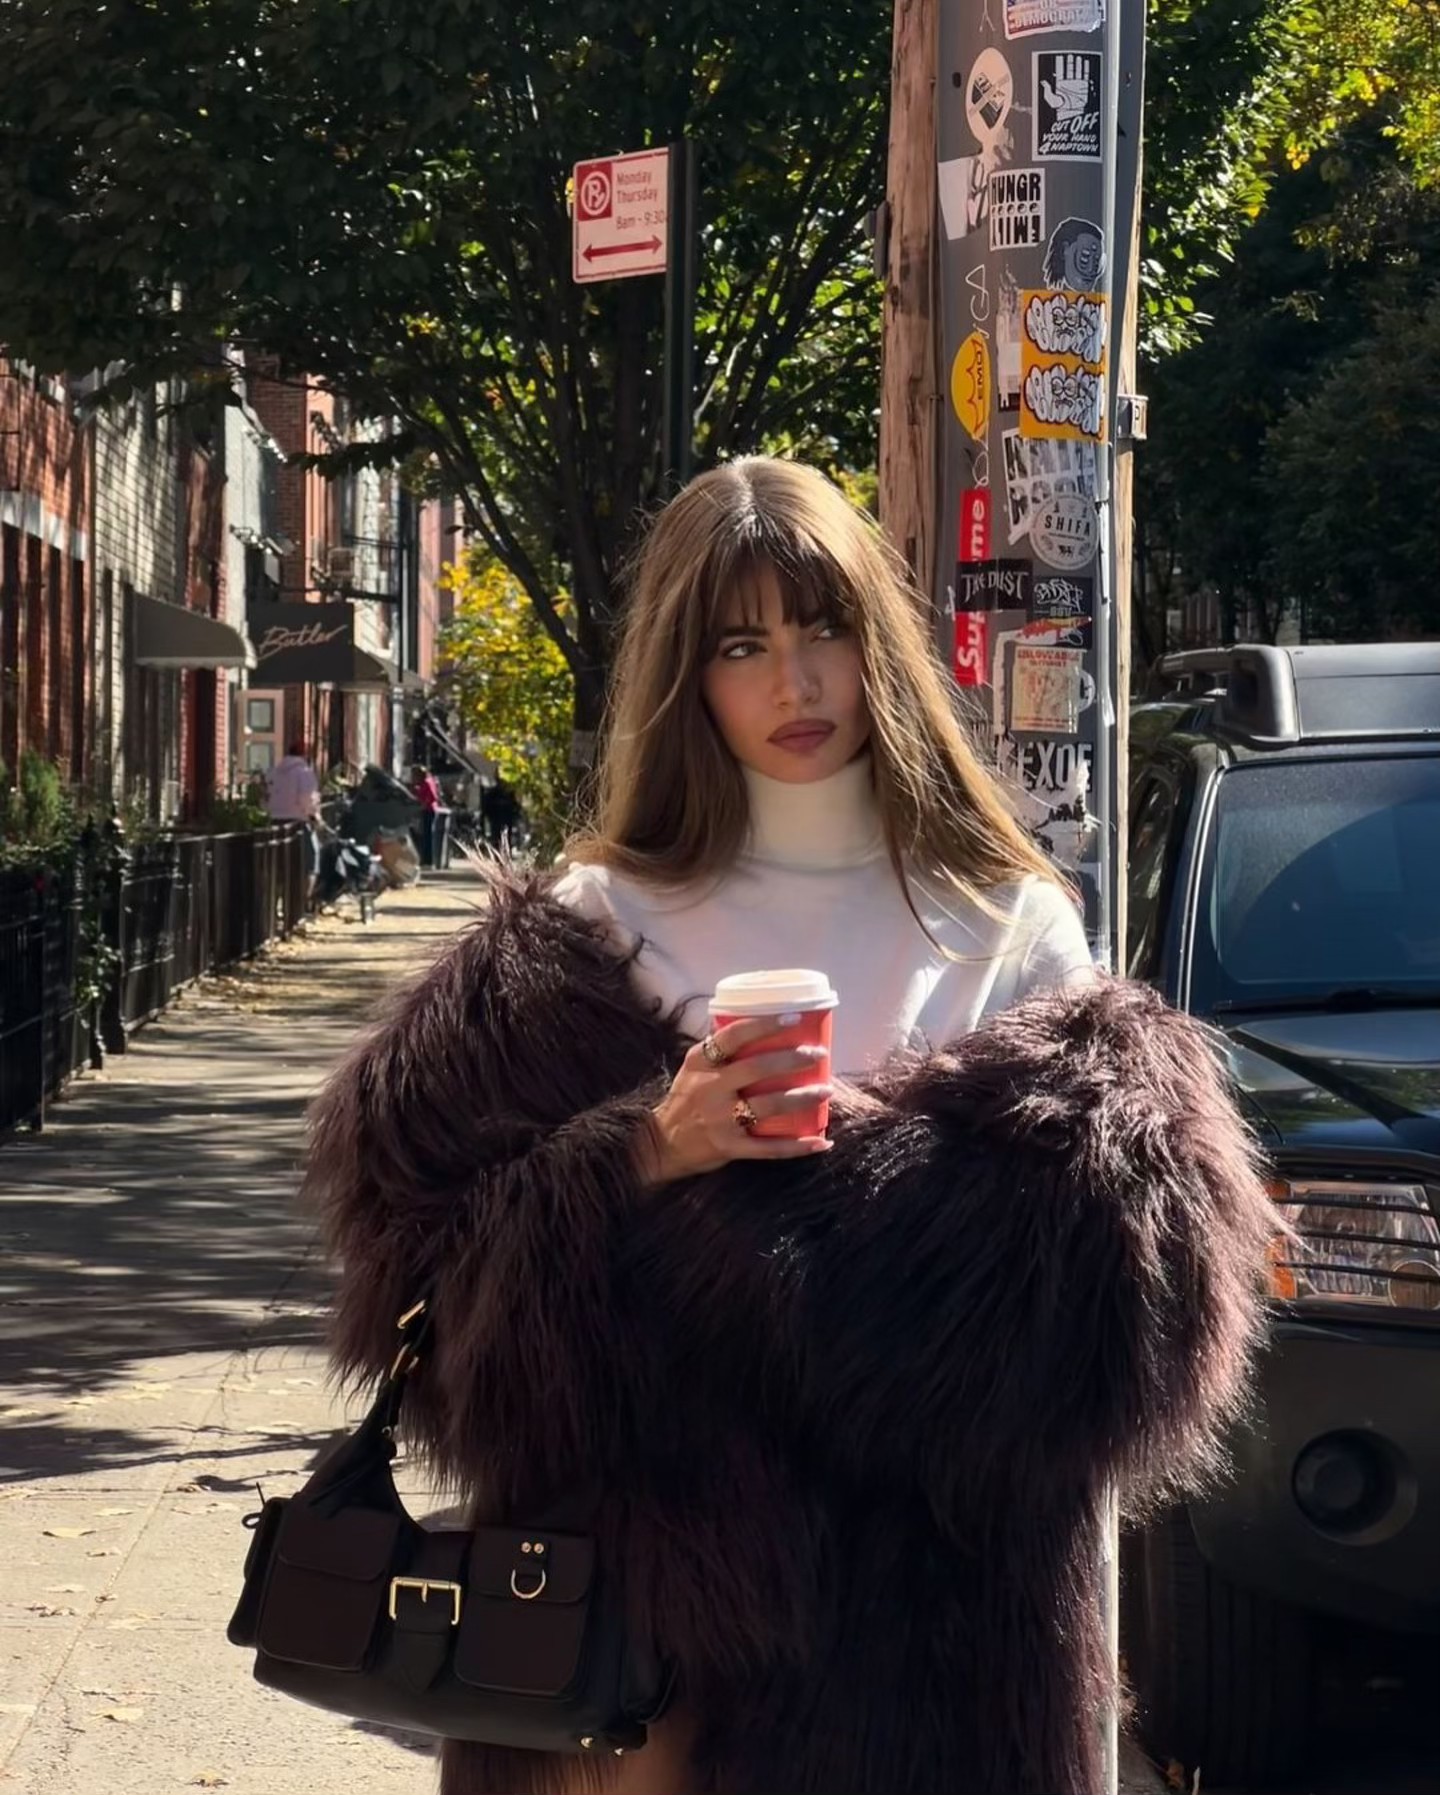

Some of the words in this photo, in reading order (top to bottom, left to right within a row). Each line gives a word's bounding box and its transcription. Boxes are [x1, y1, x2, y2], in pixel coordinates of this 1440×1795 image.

[1051, 120, 1070, 132] CUT
[1070, 111, 1099, 133] OFF
[1043, 132, 1069, 142] YOUR
[1071, 133, 1097, 143] HAND
[1039, 142, 1051, 155] 4
[617, 171, 652, 185] Monday
[617, 188, 658, 203] Thursday
[616, 215, 637, 230] 8am
[1044, 514, 1091, 536] SHIFA
